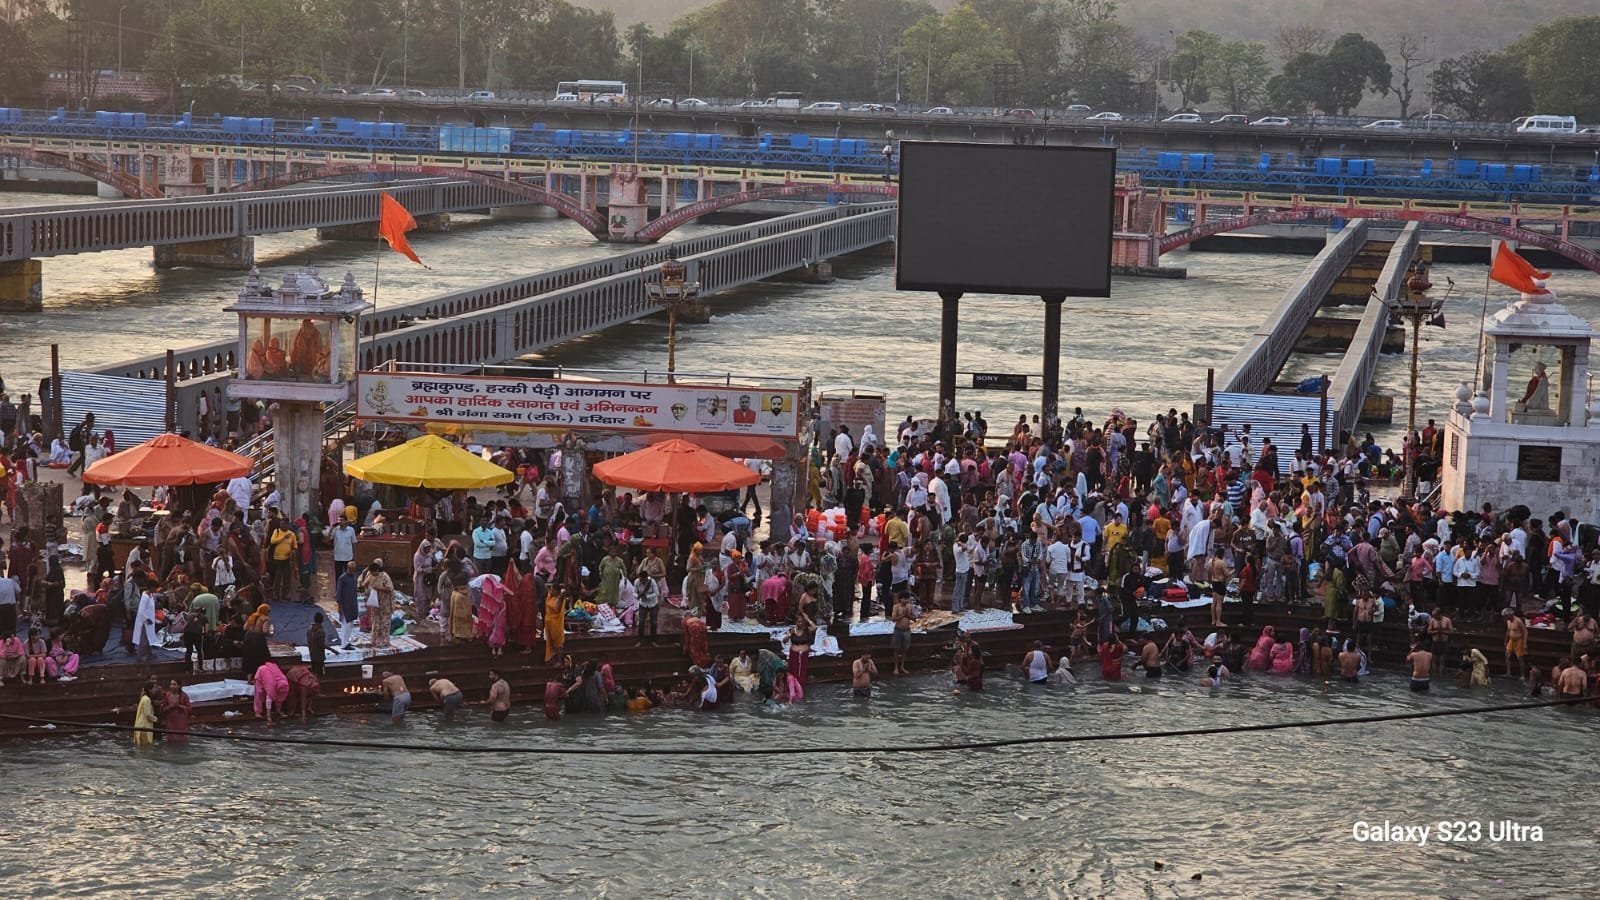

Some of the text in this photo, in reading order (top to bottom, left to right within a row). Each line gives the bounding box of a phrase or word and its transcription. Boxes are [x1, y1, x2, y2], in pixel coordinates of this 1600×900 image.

[485, 382, 528, 394] हरकी
[532, 384, 560, 399] पैड़ी
[564, 387, 626, 398] आगमन
[630, 390, 652, 399] पर
[404, 395, 659, 414] आपका हार्दिक स्वागत एवं अभिनन्दन
[435, 407, 626, 425] श्री गंगा सभा (रजि.) हरिद्वार
